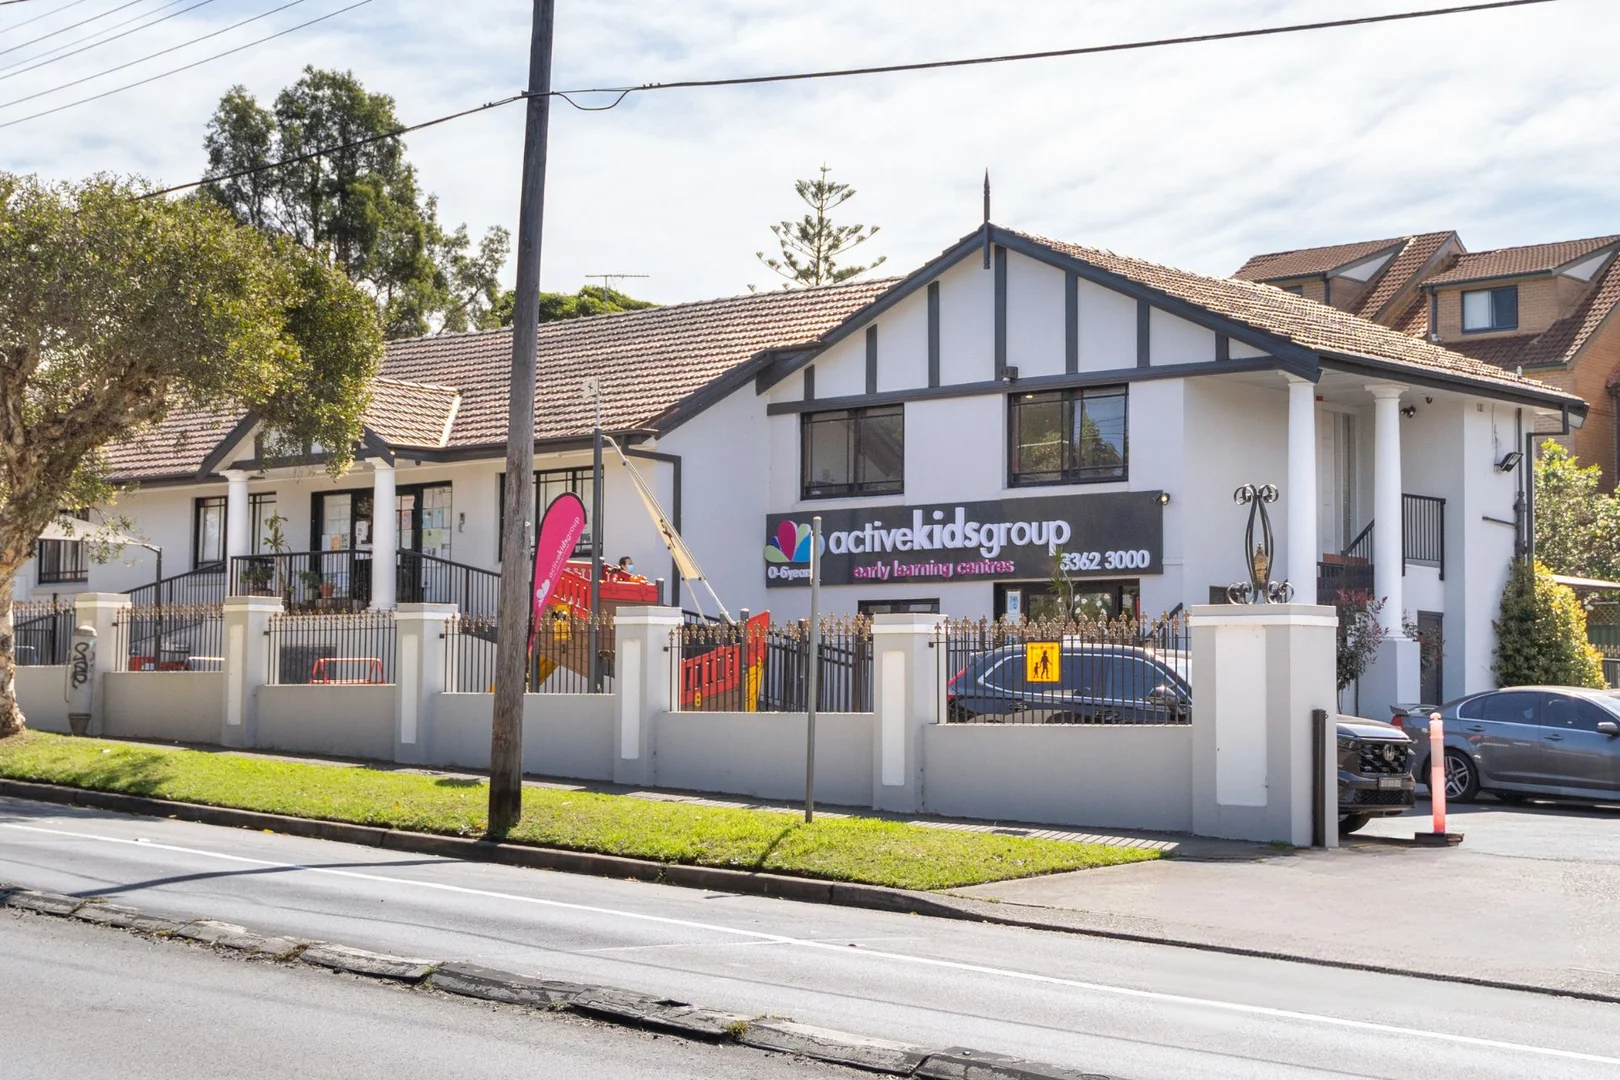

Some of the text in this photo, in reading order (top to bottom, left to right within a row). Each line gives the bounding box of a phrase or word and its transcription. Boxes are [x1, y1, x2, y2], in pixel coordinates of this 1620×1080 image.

[829, 507, 1072, 558] activekidsgroup
[853, 558, 1015, 580] early learning centres
[1104, 549, 1151, 570] 3000
